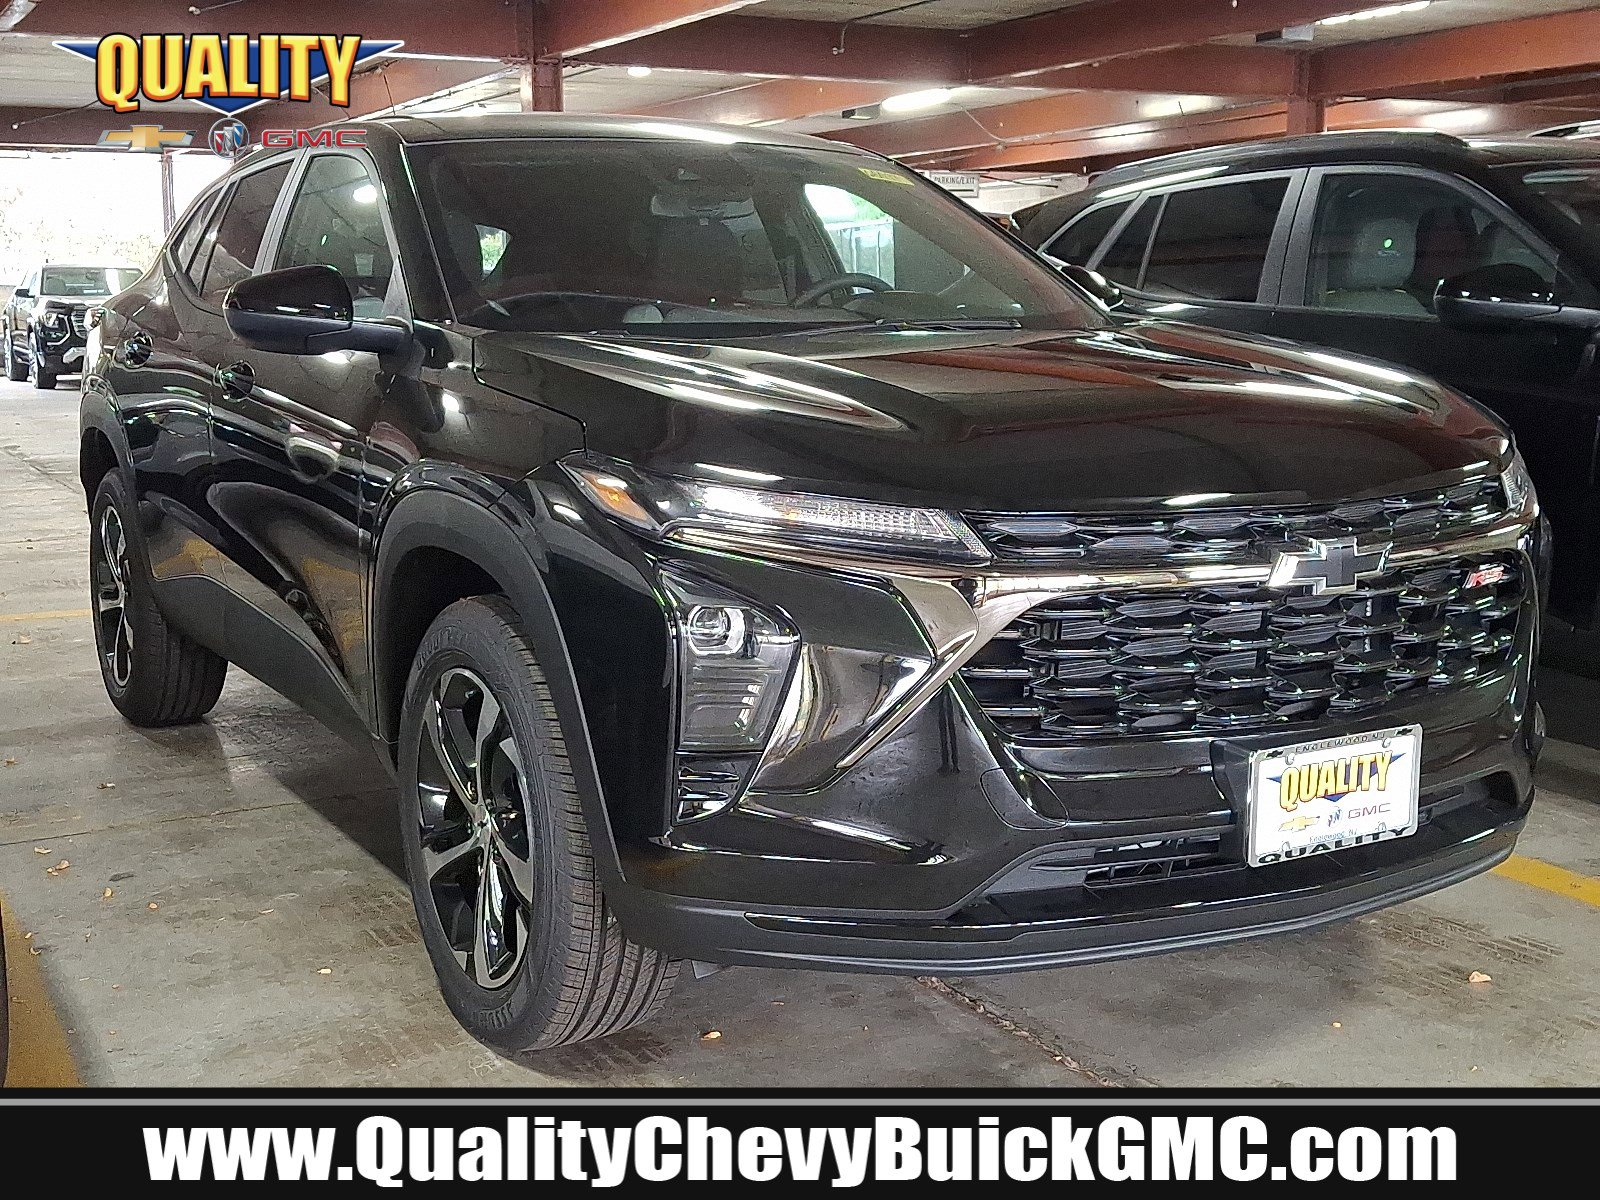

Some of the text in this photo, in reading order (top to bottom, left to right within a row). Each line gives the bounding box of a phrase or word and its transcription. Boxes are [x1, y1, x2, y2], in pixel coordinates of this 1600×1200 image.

[933, 175, 976, 185] PARKING/EXIT
[1279, 750, 1393, 812] QUALITY
[1347, 802, 1392, 819] GMC
[1258, 826, 1411, 863] QUALITY
